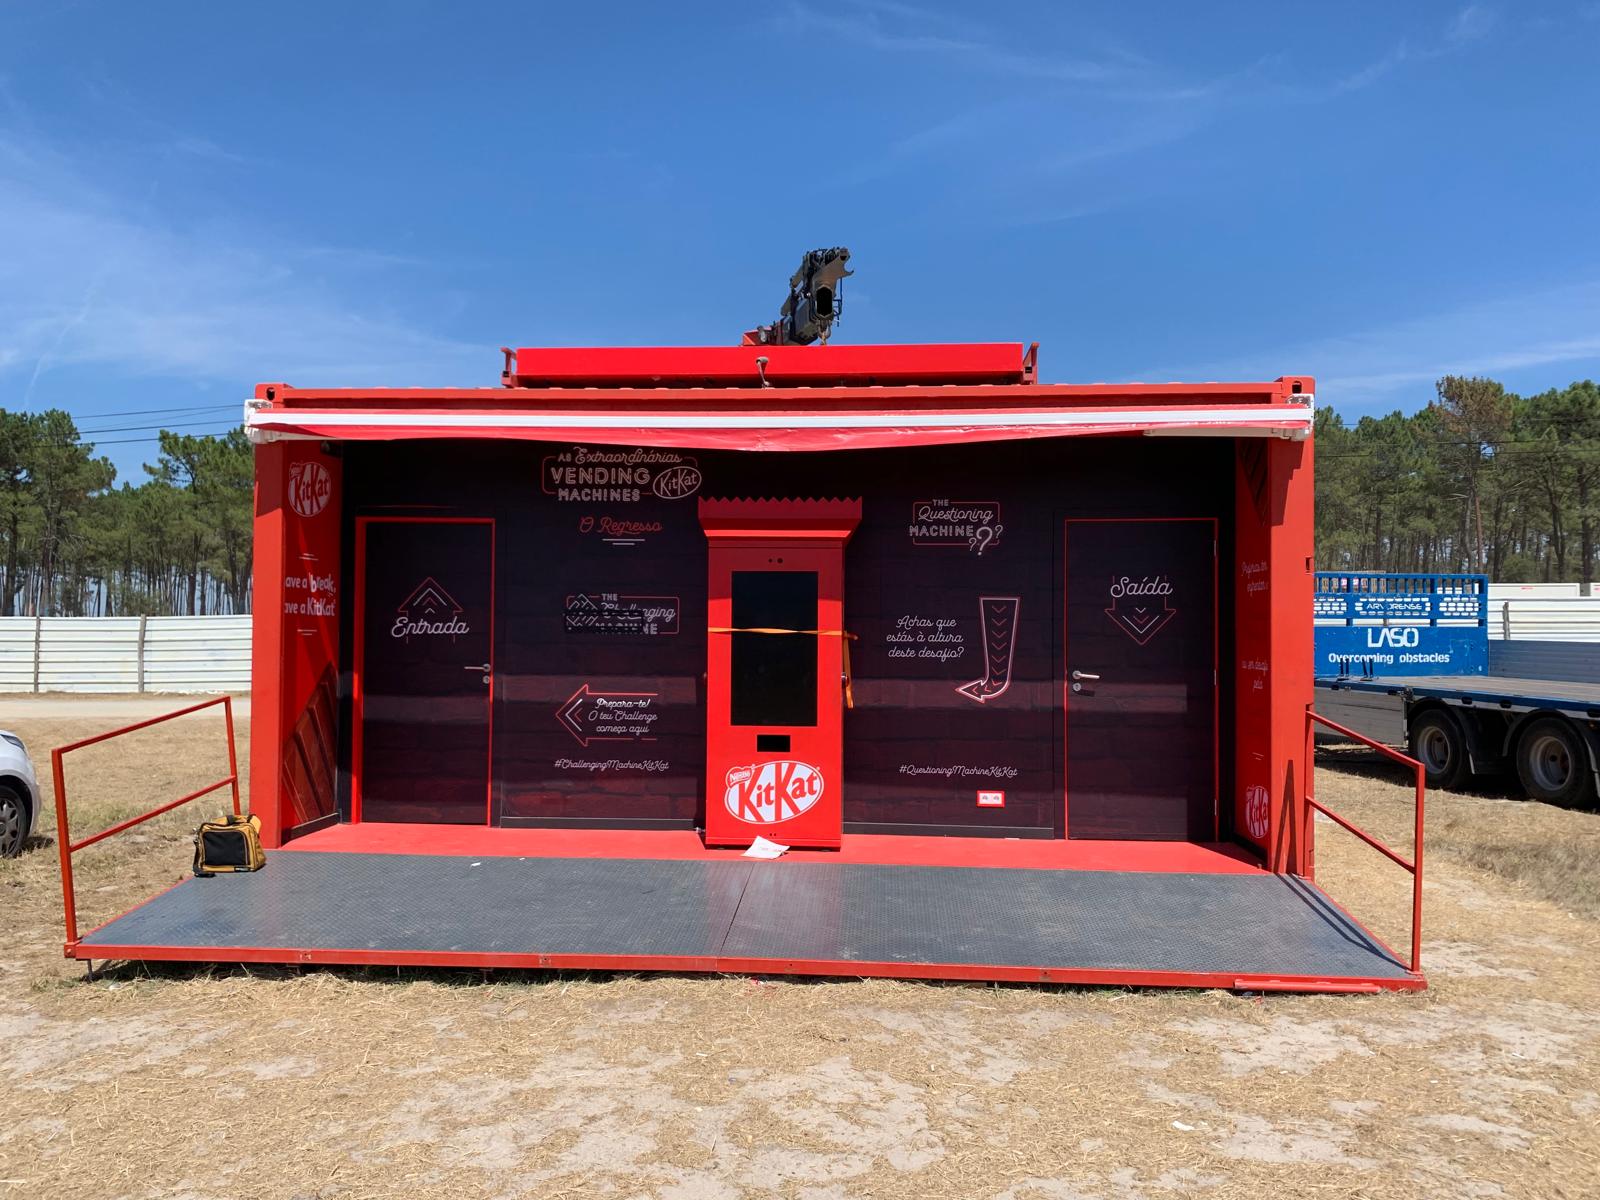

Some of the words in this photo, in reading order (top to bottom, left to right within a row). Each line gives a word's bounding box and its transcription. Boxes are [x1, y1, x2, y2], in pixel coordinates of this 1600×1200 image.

[573, 446, 683, 465] Extraordinárias
[551, 467, 651, 485] VENDING
[660, 468, 698, 497] KitKat
[292, 464, 329, 514] KitKat
[558, 488, 641, 501] MACHINES
[918, 505, 994, 525] Questioning
[579, 516, 594, 533] O
[597, 517, 663, 536] Regresso
[302, 578, 308, 589] a
[1110, 576, 1173, 598] Saída
[601, 593, 618, 601] THE
[300, 604, 307, 615] a
[307, 597, 336, 617] KitKat
[391, 616, 470, 638] Entrada
[896, 615, 934, 630] Achas
[935, 618, 957, 631] que
[886, 631, 915, 643] estás
[927, 631, 964, 643] altura
[1367, 628, 1419, 648] LASO
[888, 646, 916, 658] deste
[918, 646, 965, 662] desafio?
[1328, 652, 1394, 665] Overcoming
[1399, 653, 1450, 663] obstacles
[595, 697, 651, 711] Prepara-te!
[588, 710, 599, 721] O
[599, 711, 613, 720] teu
[613, 709, 658, 724] Challenge
[596, 725, 628, 734] começa
[628, 725, 650, 736] aqui
[554, 758, 670, 772] #ChallengingMachineKitKat
[899, 764, 1018, 778] #QuestioningMachineKitKat
[737, 762, 818, 822] KitKat
[1247, 786, 1269, 837] KitKa
